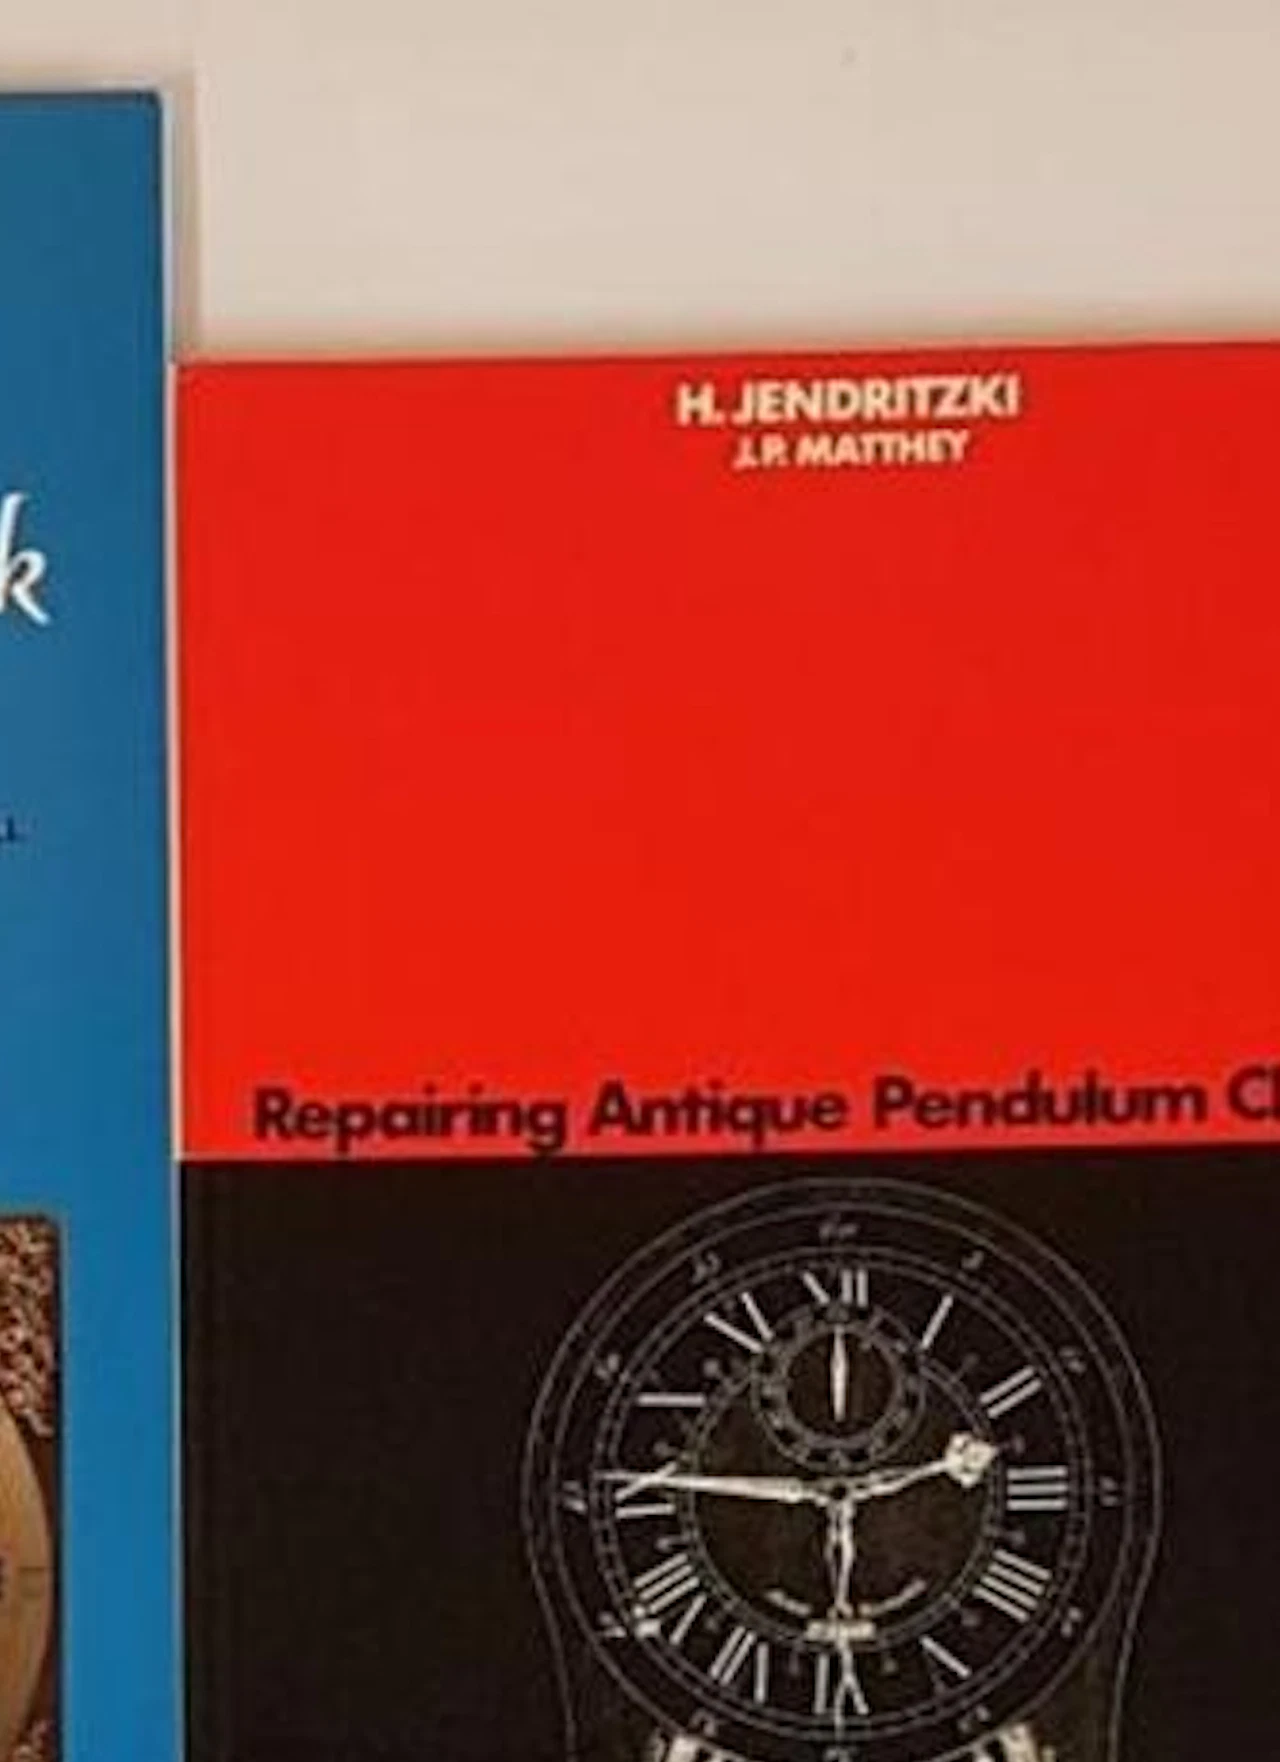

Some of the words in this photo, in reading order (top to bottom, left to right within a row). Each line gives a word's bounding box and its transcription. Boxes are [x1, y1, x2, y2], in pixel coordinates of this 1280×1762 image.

[677, 381, 725, 424] H.
[730, 374, 1020, 424] JENDRITZKI
[794, 428, 968, 467] MATTHEY
[253, 1083, 568, 1155] Repairing
[588, 1081, 848, 1146] Antique
[874, 1067, 1207, 1134] Pendulum
